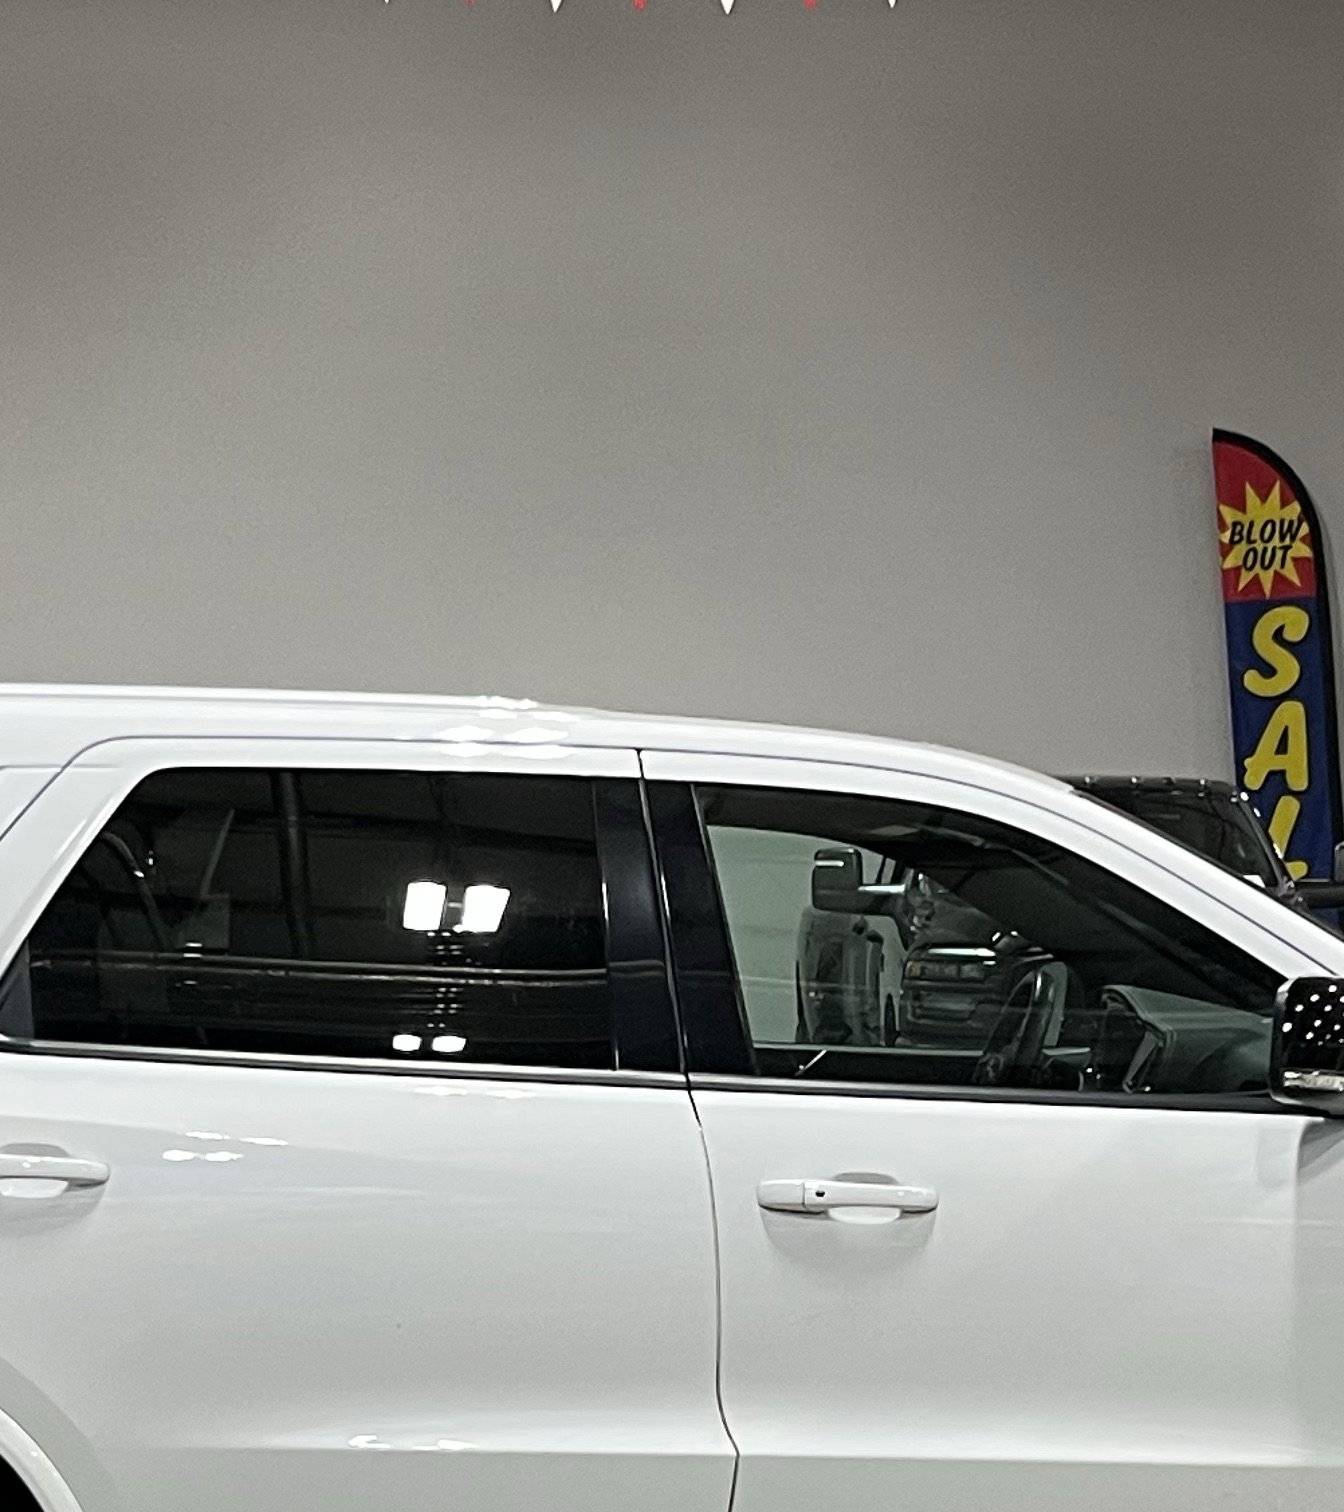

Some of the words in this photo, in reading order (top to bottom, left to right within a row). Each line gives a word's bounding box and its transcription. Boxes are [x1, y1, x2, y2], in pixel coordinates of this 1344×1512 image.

[1228, 518, 1303, 546] BLOW
[1241, 543, 1293, 573] OUT
[1242, 605, 1311, 881] SAL
